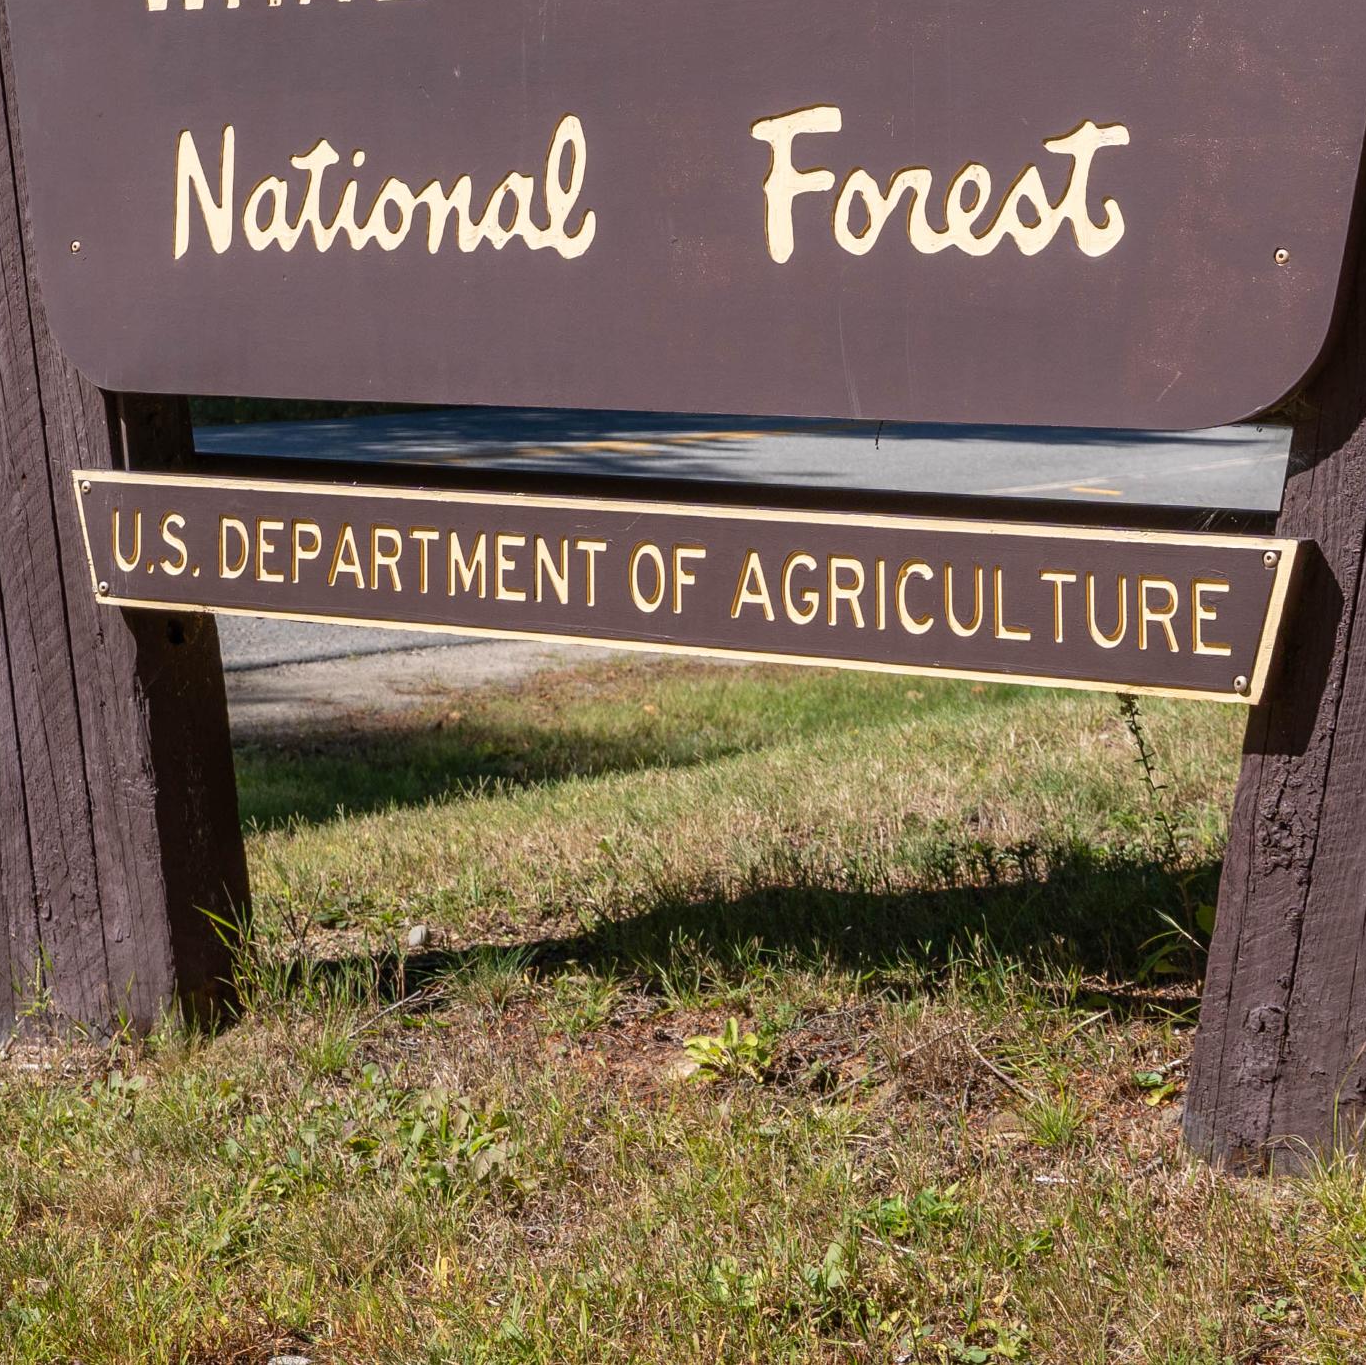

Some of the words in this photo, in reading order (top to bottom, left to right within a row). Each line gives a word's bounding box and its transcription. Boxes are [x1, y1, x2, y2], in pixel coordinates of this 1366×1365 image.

[173, 113, 598, 260] National
[752, 105, 1130, 264] Forest
[112, 508, 201, 577] U.S.
[218, 516, 610, 607] DEPARTMENT
[629, 542, 708, 615] OF
[730, 547, 1234, 657] AGRICULTURE
